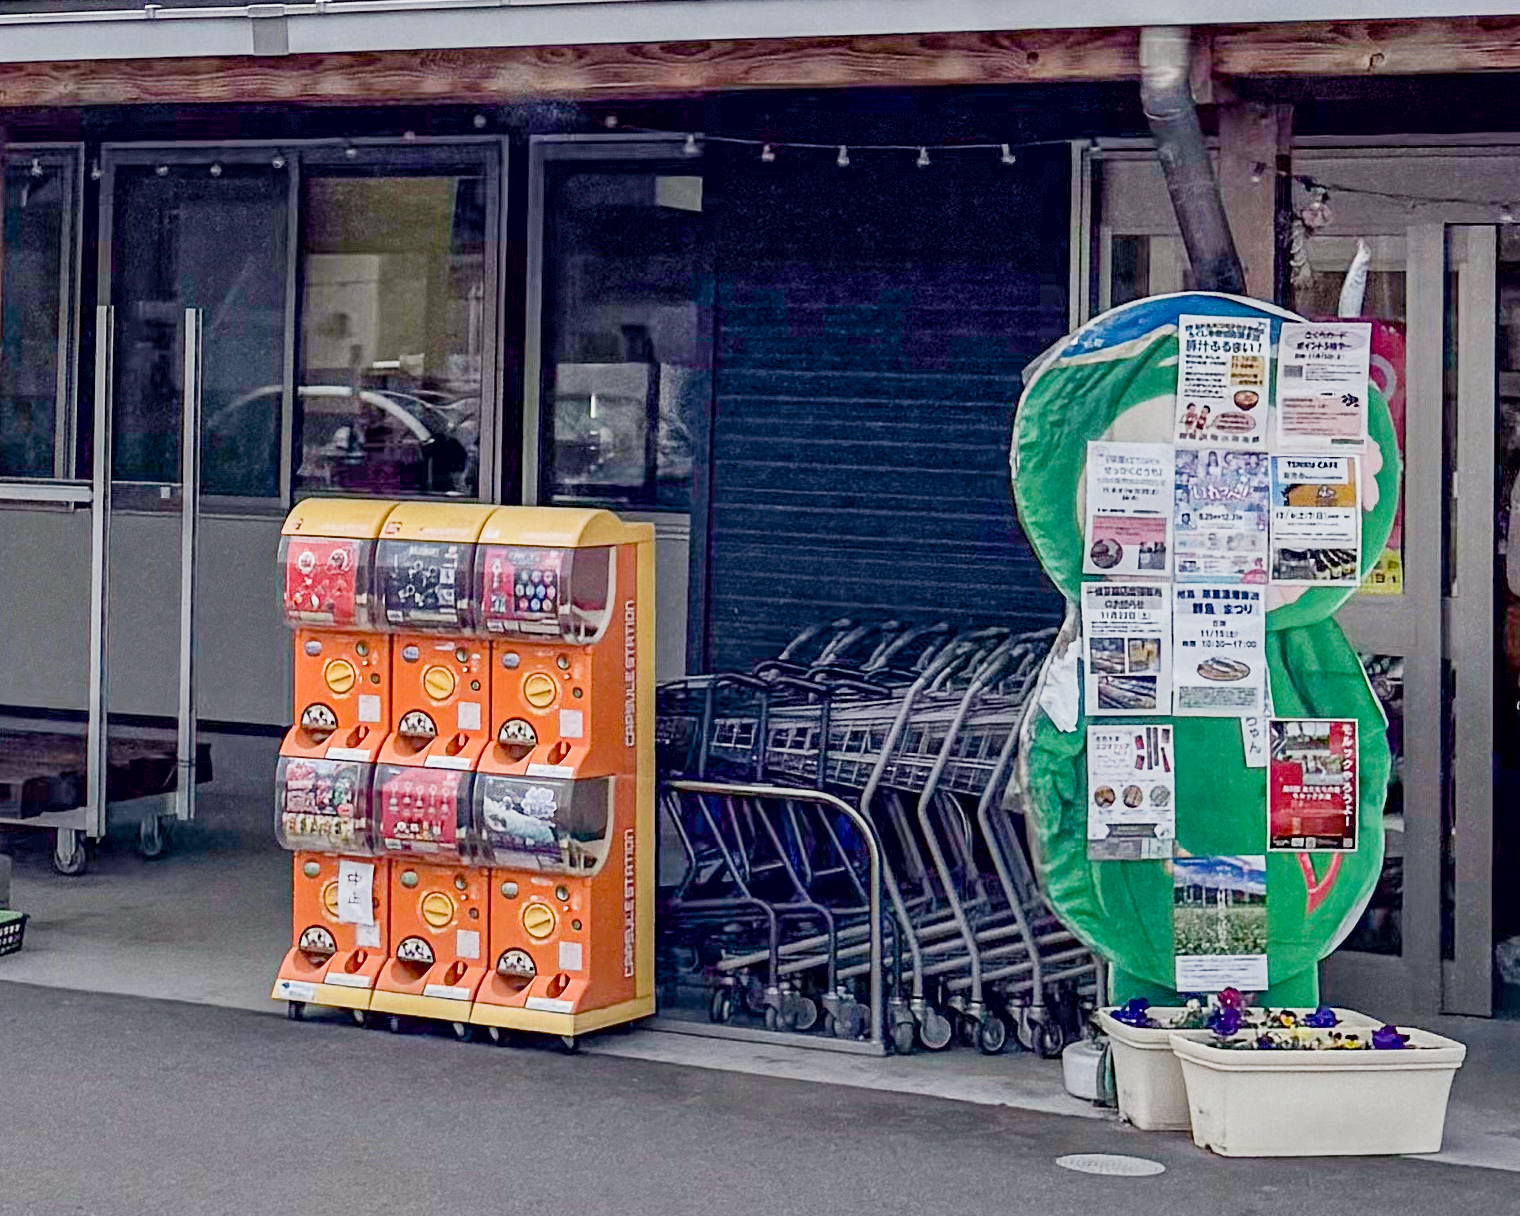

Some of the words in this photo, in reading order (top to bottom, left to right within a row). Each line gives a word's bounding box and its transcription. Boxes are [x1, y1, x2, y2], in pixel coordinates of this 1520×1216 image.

[1224, 604, 1252, 615] まつり
[348, 871, 362, 904] 中止
